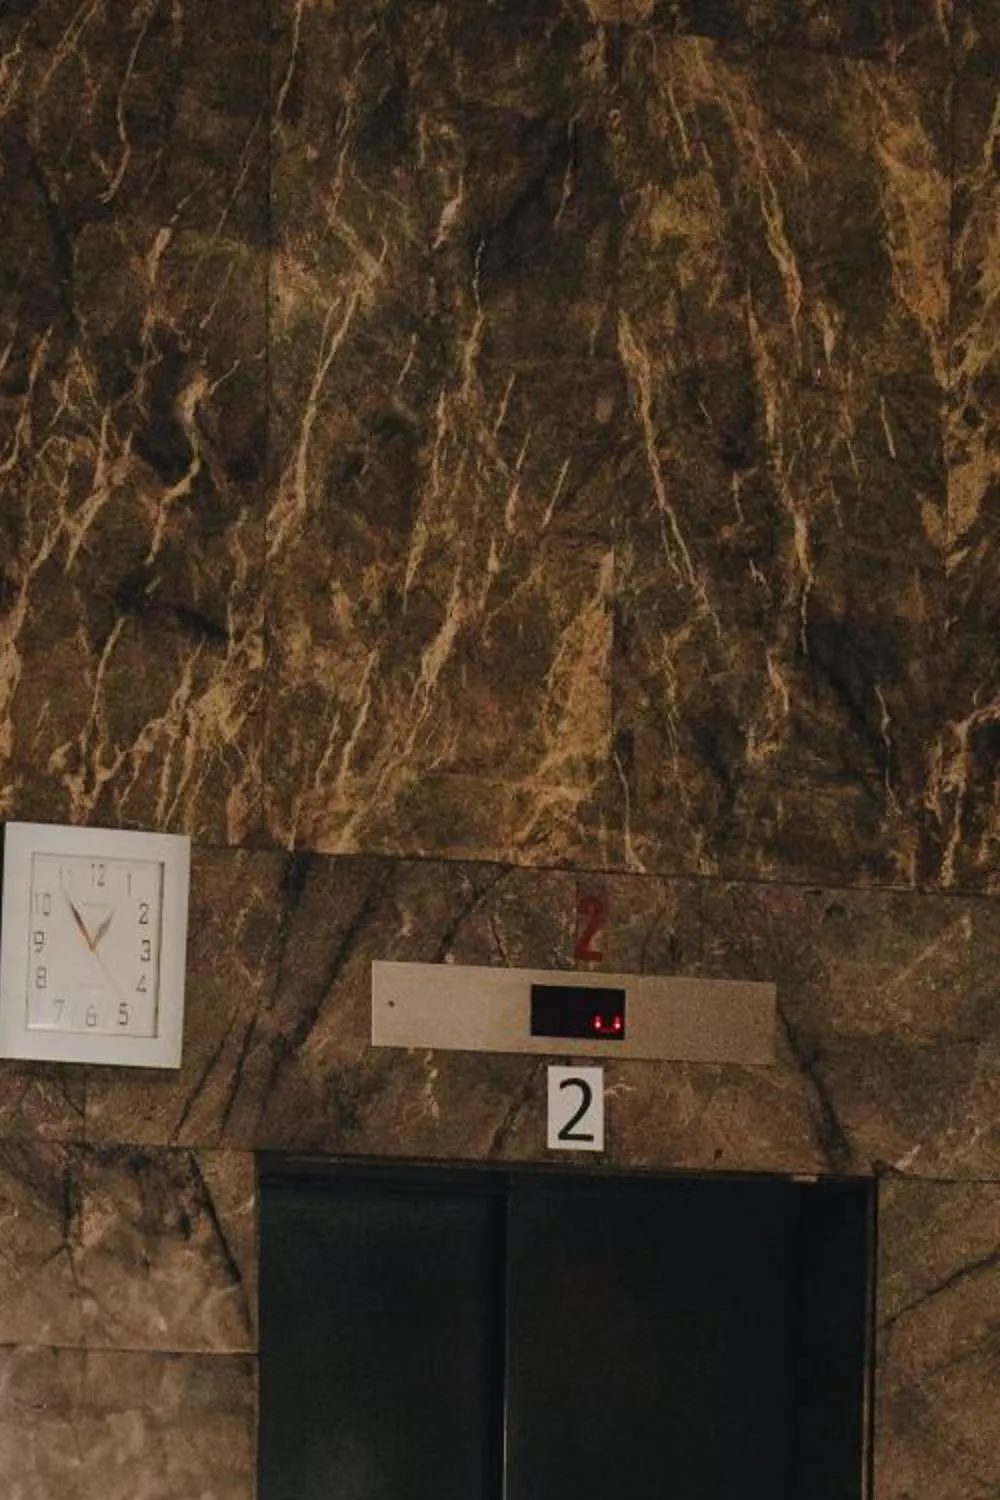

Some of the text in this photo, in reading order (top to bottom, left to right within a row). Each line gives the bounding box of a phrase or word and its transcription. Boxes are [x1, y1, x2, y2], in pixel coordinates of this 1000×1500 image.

[91, 863, 105, 887] 12
[126, 872, 132, 898] 1
[35, 893, 51, 916] 10
[138, 902, 149, 925] 2
[575, 894, 604, 961] 2
[33, 930, 45, 953] 9
[140, 939, 151, 962] 3
[35, 966, 47, 989] 8
[53, 999, 65, 1023] 7
[85, 1004, 97, 1028] 6
[118, 1002, 129, 1026] 5
[557, 1077, 595, 1142] 2
